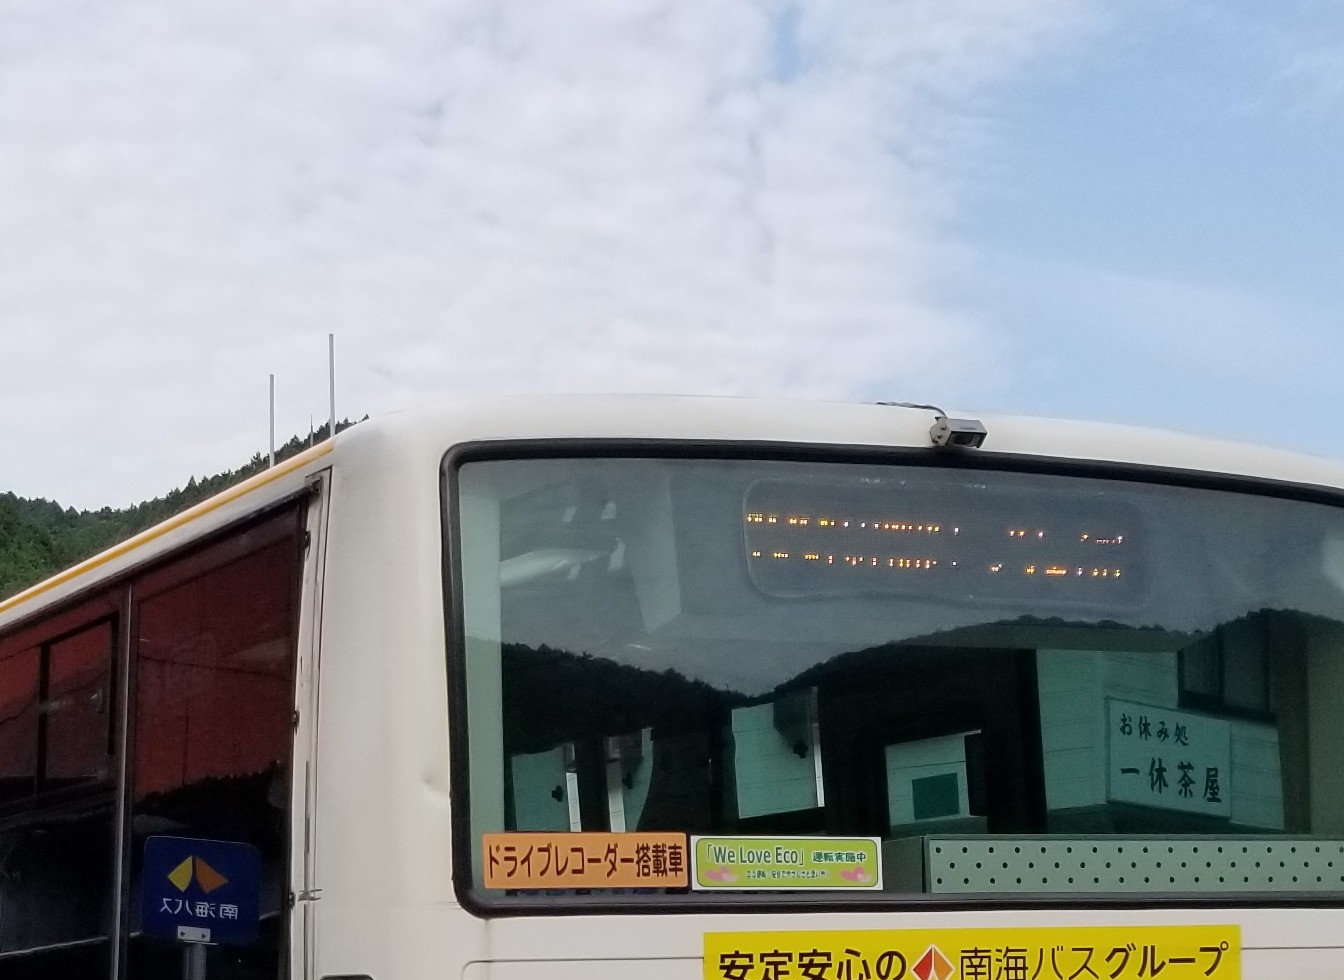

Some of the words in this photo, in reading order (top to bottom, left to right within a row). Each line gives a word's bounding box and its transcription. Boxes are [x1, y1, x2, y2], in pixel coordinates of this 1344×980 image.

[1119, 712, 1190, 746] お休み処
[1120, 757, 1222, 803] 一休茶屋
[487, 840, 685, 879] ドライブレコーダー搭載車
[739, 845, 771, 864] Love
